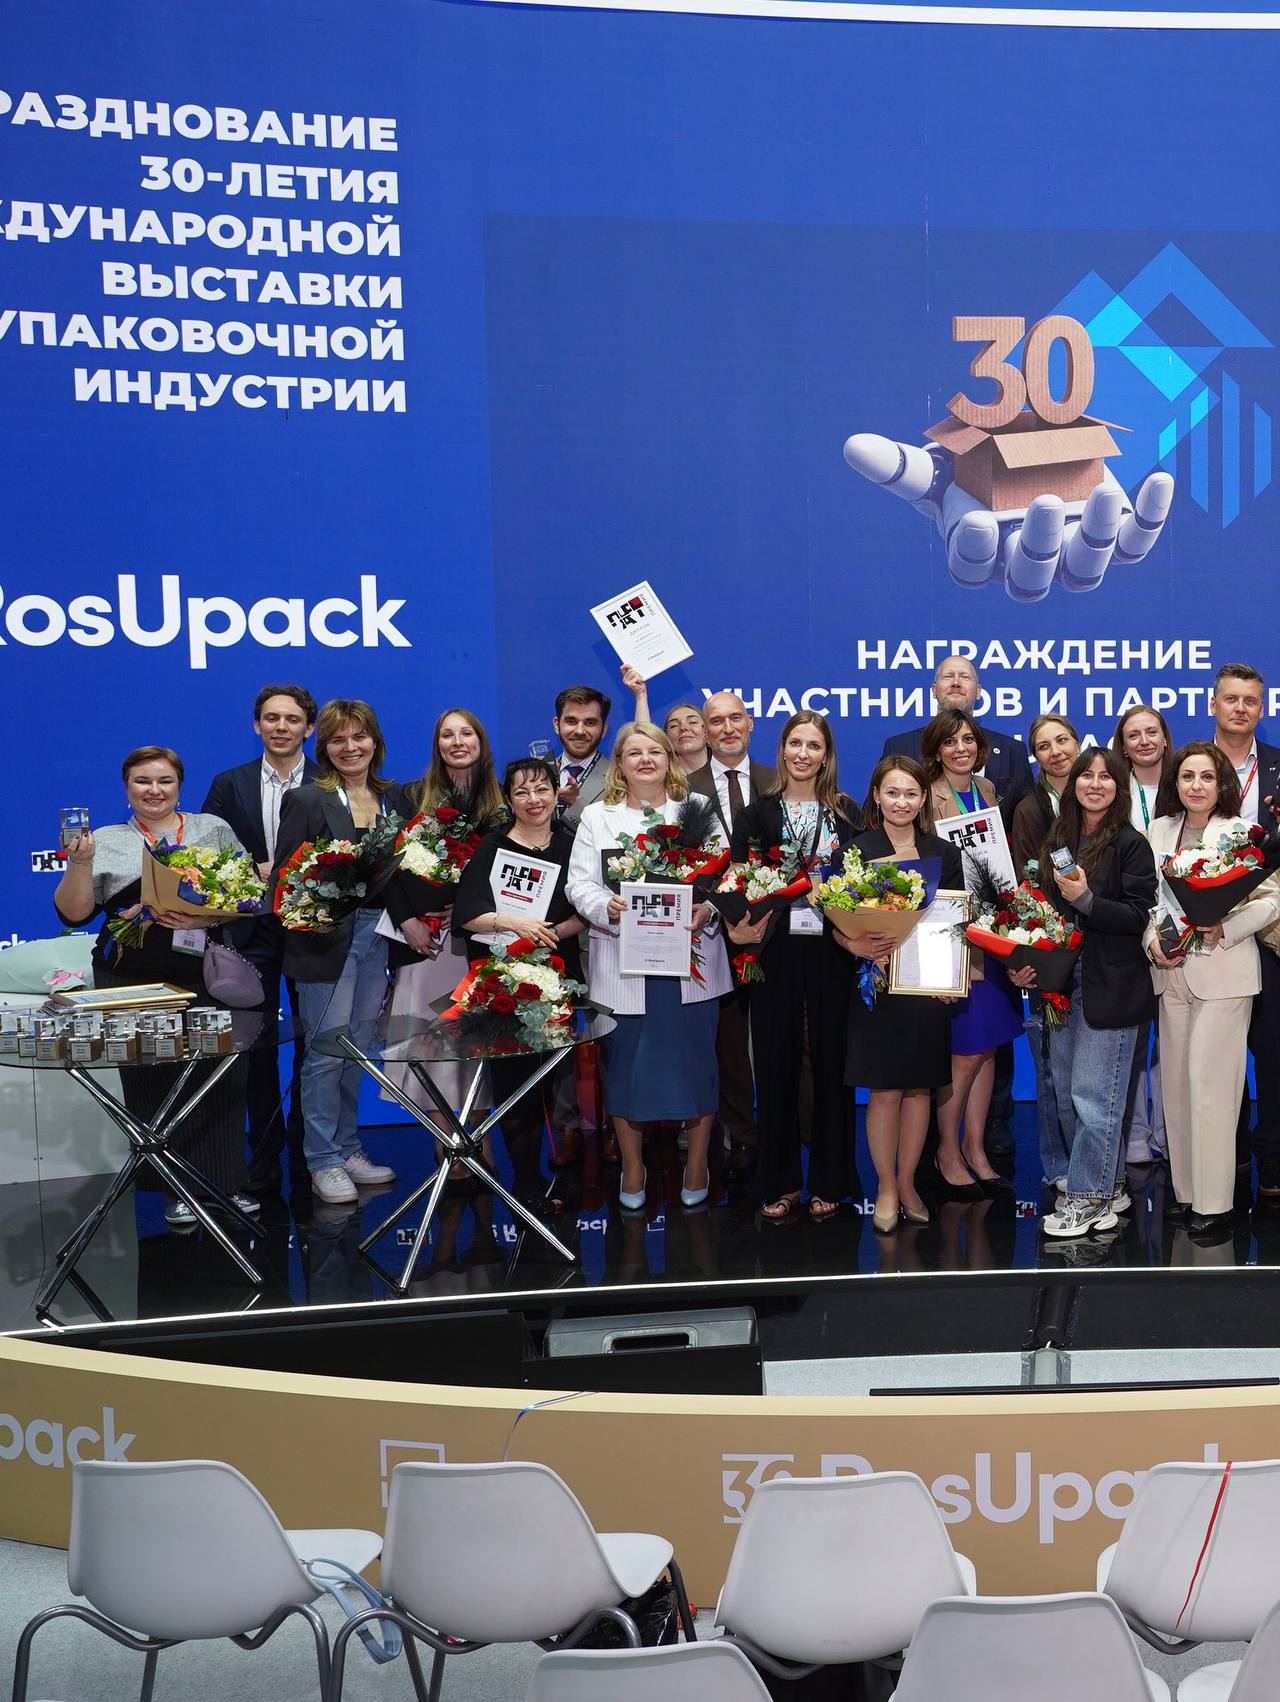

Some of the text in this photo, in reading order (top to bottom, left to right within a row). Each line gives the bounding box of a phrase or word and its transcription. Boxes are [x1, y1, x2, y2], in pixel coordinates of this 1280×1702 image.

[140, 155, 399, 204] 30-ЛЕТИЯ
[0, 200, 401, 257] ДУНАРОДНОЙ
[102, 261, 403, 309] ВЫСТАВКИ
[74, 367, 407, 413] ИНДУСТРИИ
[947, 315, 1095, 429] 30
[0, 574, 413, 670] osUpack
[1040, 687, 1068, 716] И
